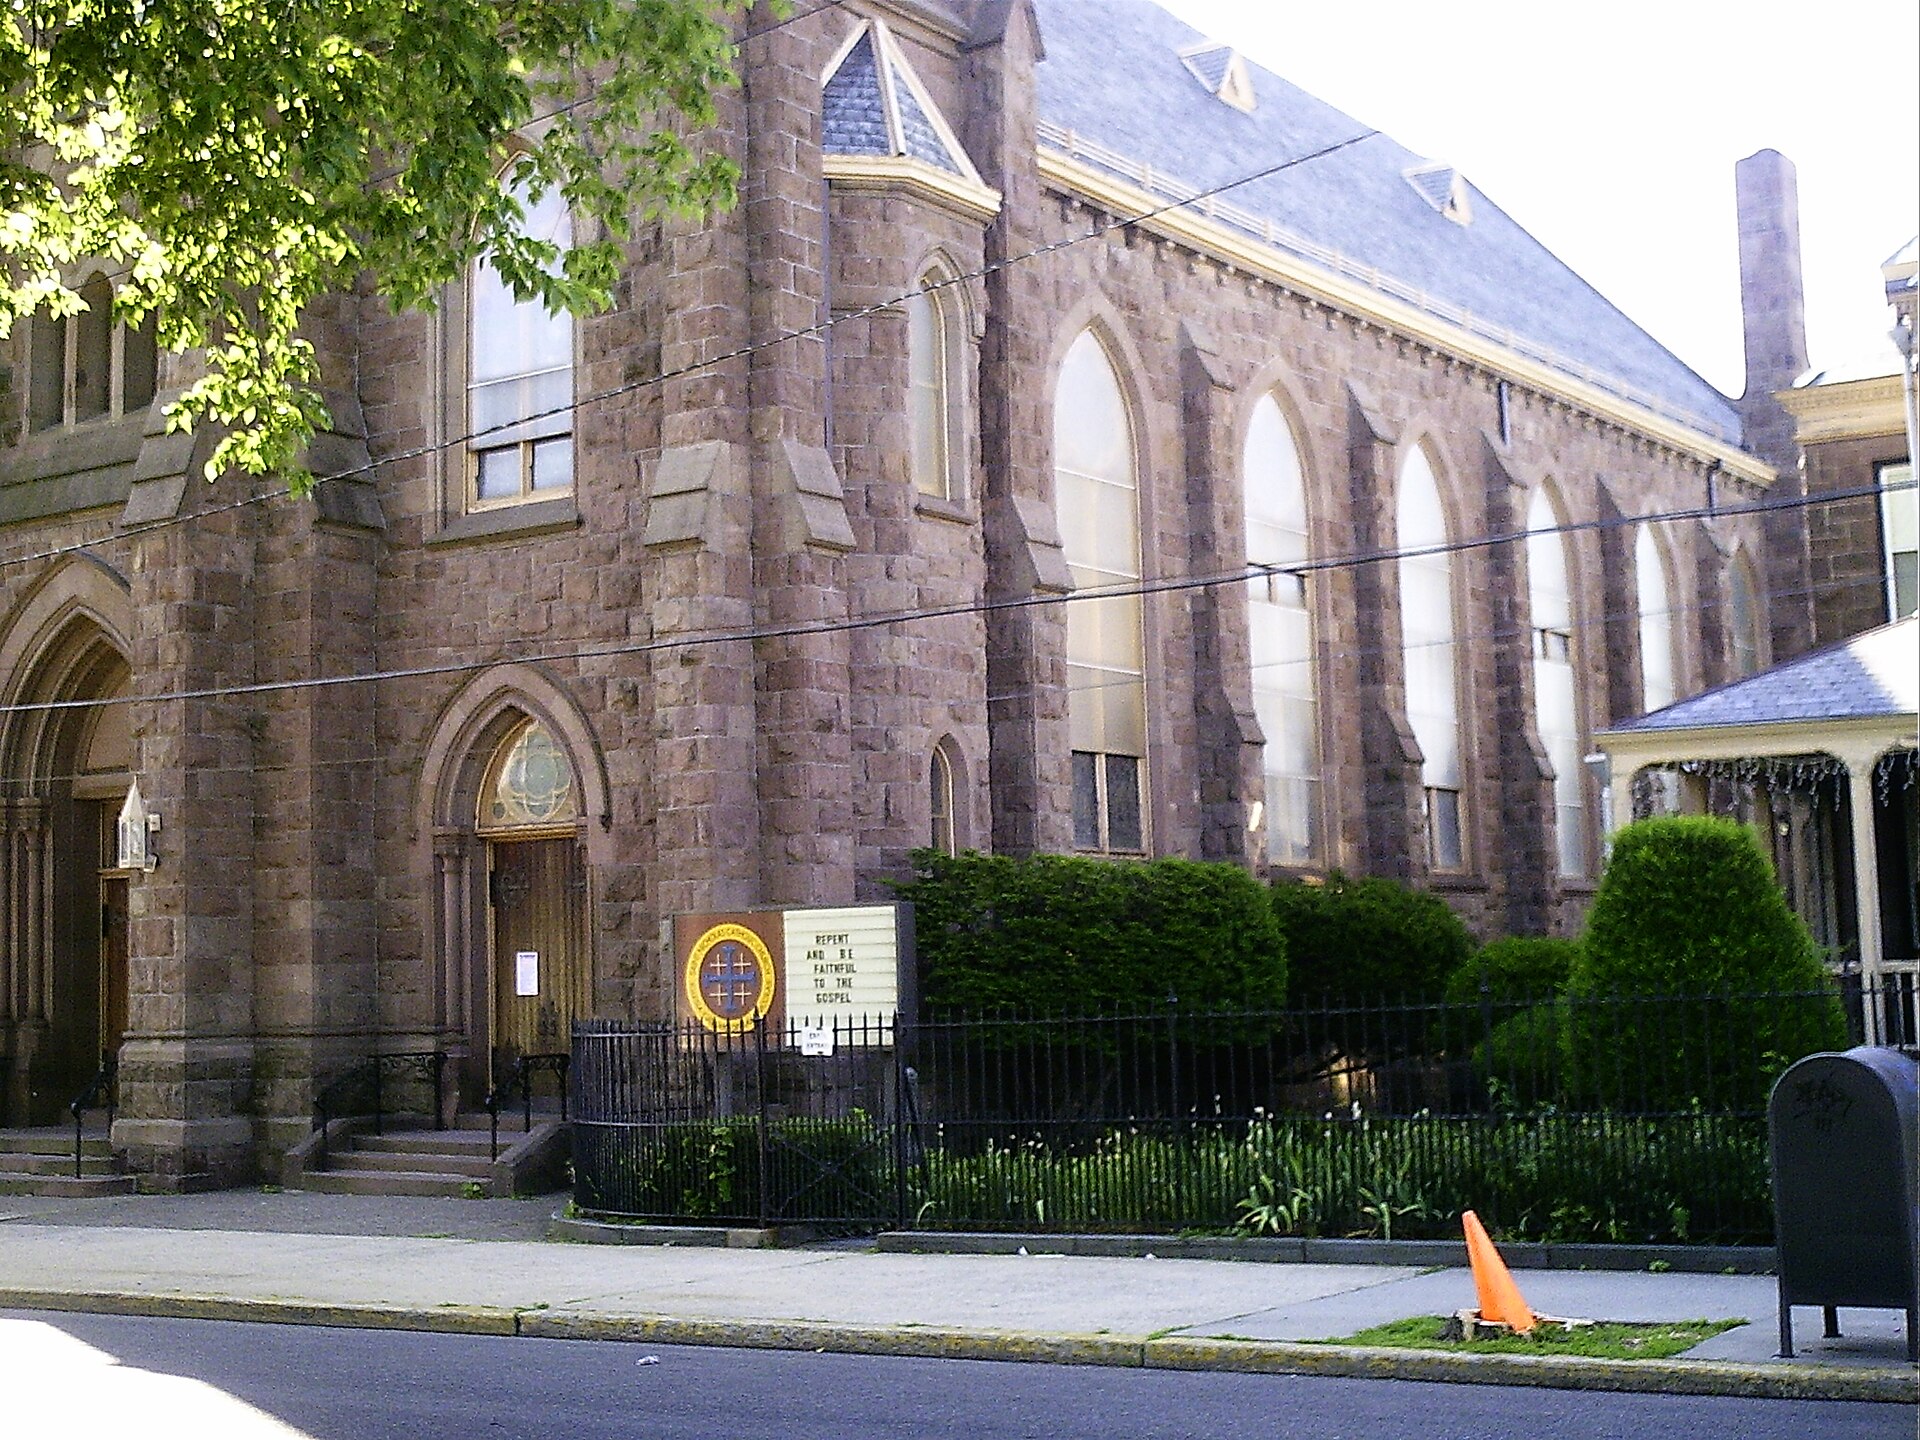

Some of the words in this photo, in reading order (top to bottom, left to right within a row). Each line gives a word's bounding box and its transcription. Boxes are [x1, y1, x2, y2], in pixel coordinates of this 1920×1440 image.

[816, 934, 849, 945] REPENT
[806, 950, 825, 960] AND
[840, 949, 853, 959] BE
[814, 963, 857, 974] FAITHFUL
[814, 978, 825, 988] TO
[836, 978, 852, 988] THE
[816, 992, 851, 1003] GOSPEL
